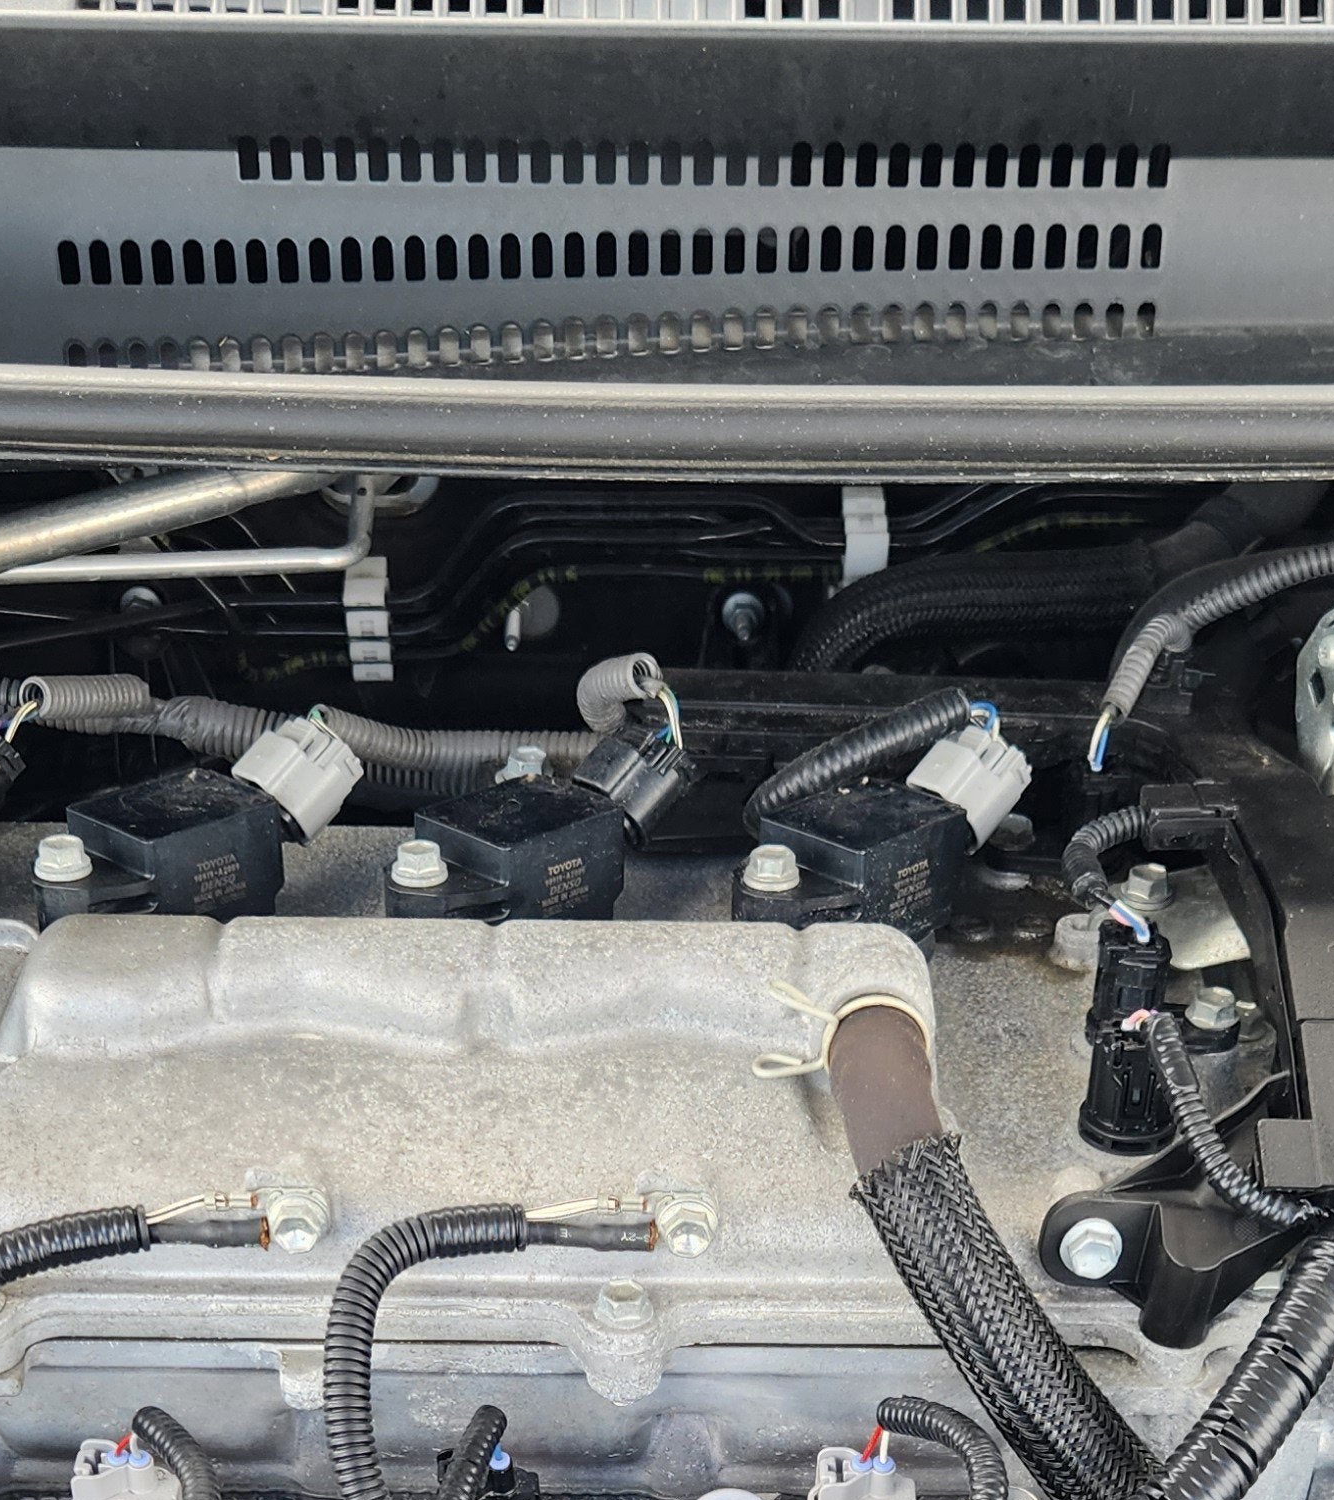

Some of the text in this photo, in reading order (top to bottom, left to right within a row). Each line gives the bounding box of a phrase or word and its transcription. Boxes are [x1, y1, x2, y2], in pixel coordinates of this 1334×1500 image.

[197, 854, 237, 872] TOYOTA
[547, 858, 583, 875] TOYOTA
[897, 859, 929, 878] TOYOTA
[201, 874, 236, 892] DENSO
[550, 877, 582, 895] DENSO
